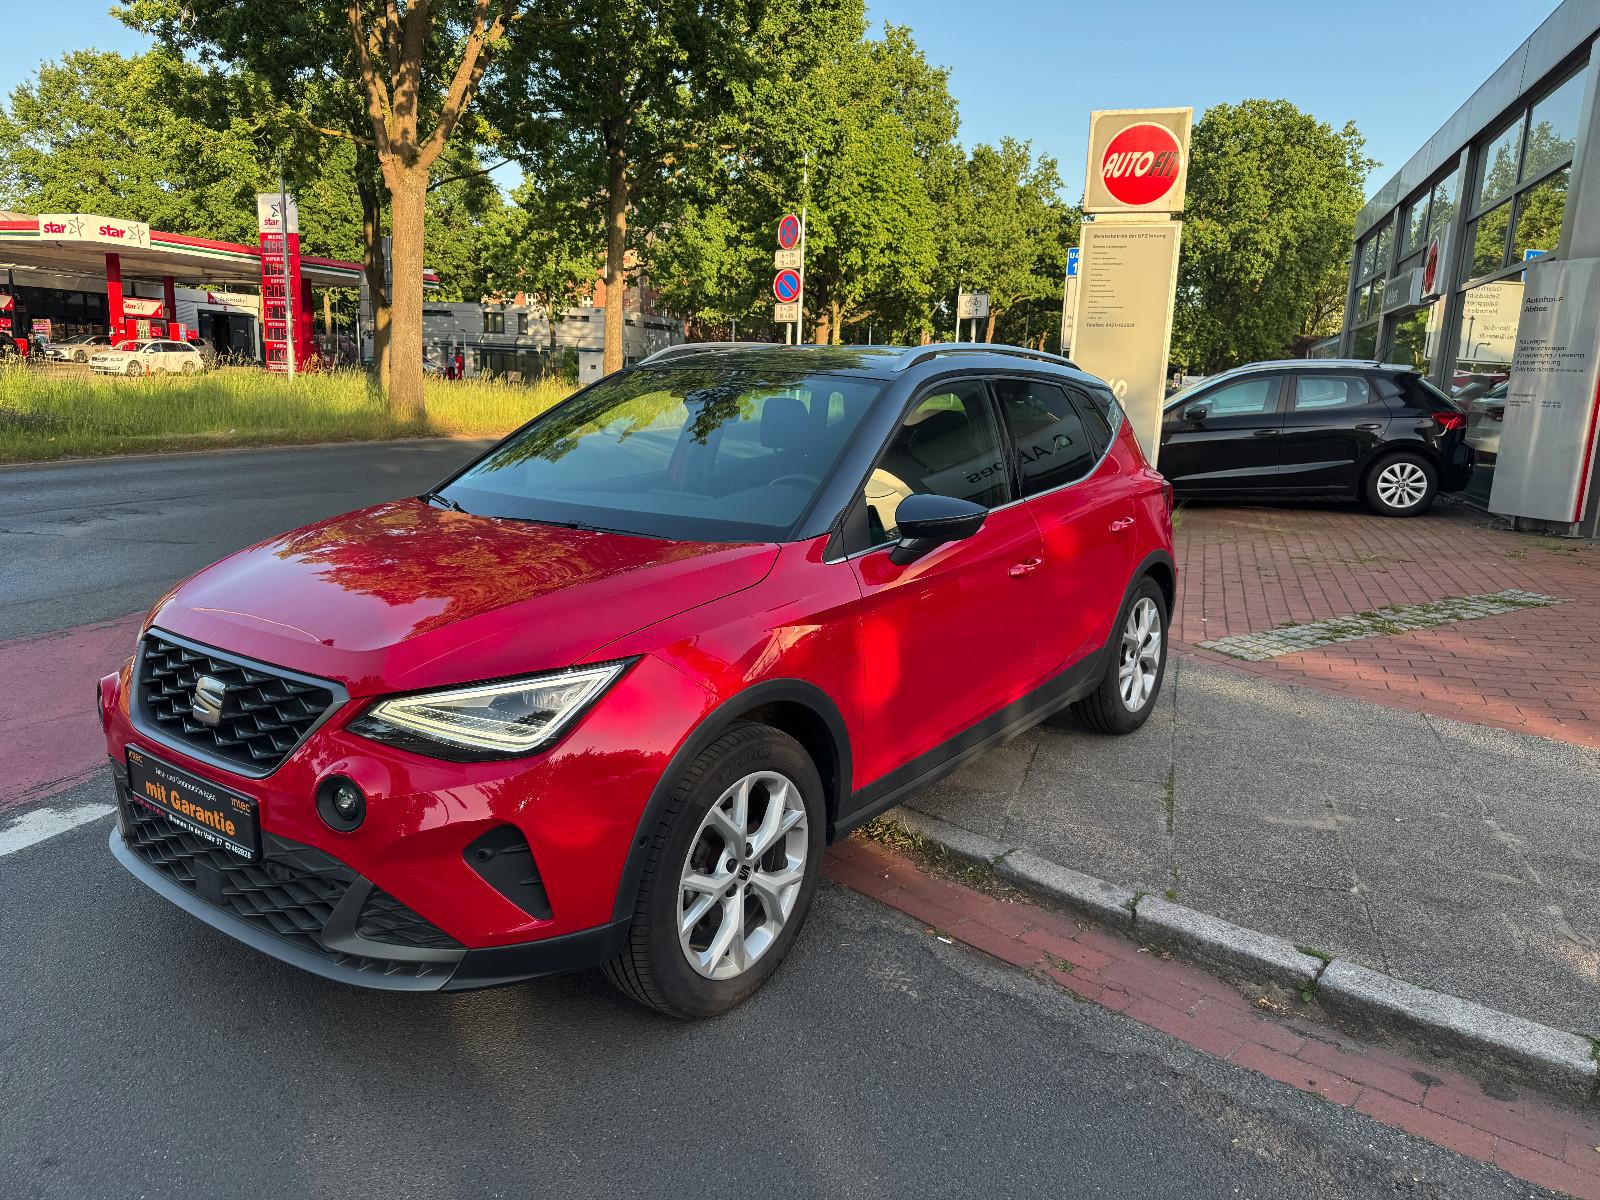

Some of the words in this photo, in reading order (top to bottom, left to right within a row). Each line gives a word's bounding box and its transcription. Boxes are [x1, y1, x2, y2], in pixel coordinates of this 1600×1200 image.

[1103, 150, 1180, 179] AUTOFIT
[43, 221, 67, 234] star
[263, 217, 280, 226] star
[98, 224, 126, 239] star
[144, 779, 167, 805] mit
[169, 789, 236, 837] Garantie
